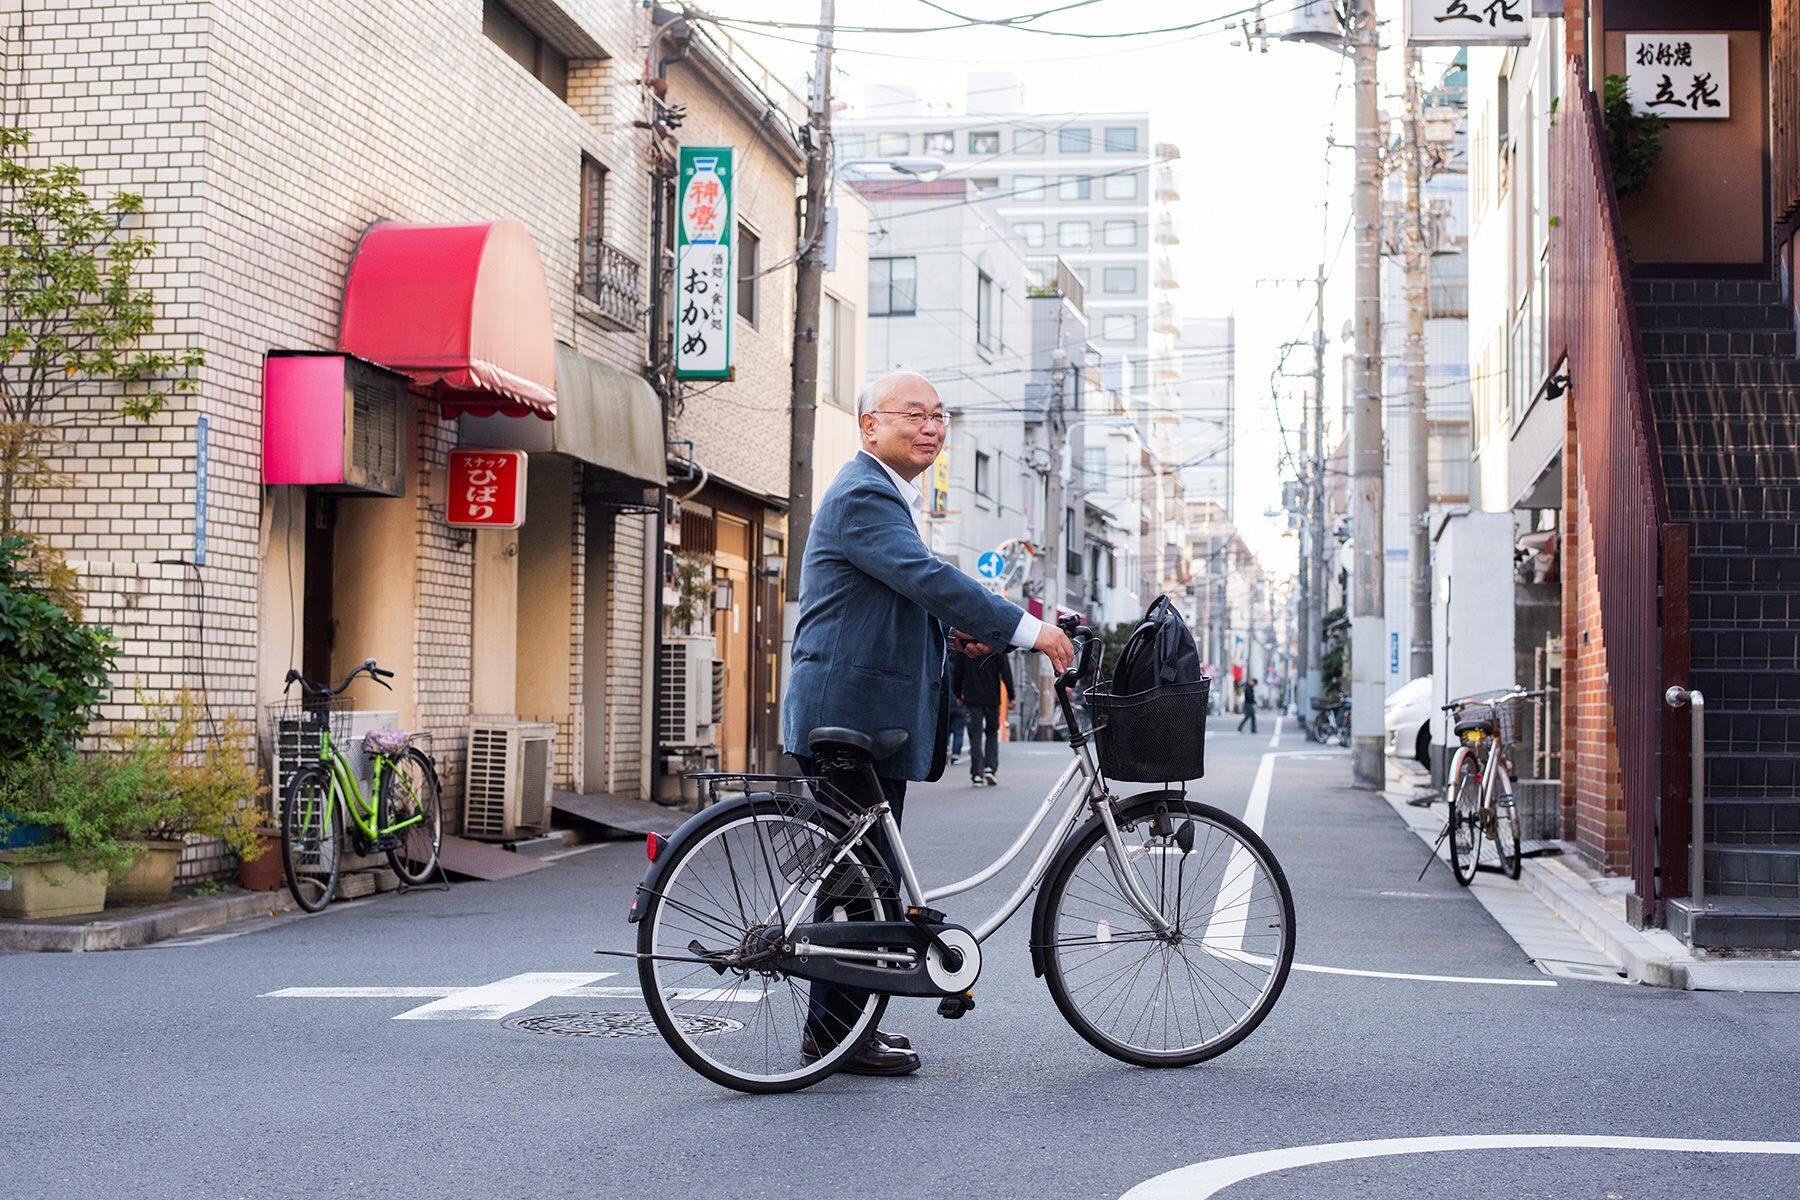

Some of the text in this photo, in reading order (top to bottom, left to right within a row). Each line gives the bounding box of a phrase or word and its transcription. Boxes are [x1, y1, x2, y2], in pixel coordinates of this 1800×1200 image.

[1645, 72, 1721, 111] 立花
[682, 267, 710, 357] おかめ
[464, 456, 507, 469] スナック
[466, 469, 498, 520] ひばり
